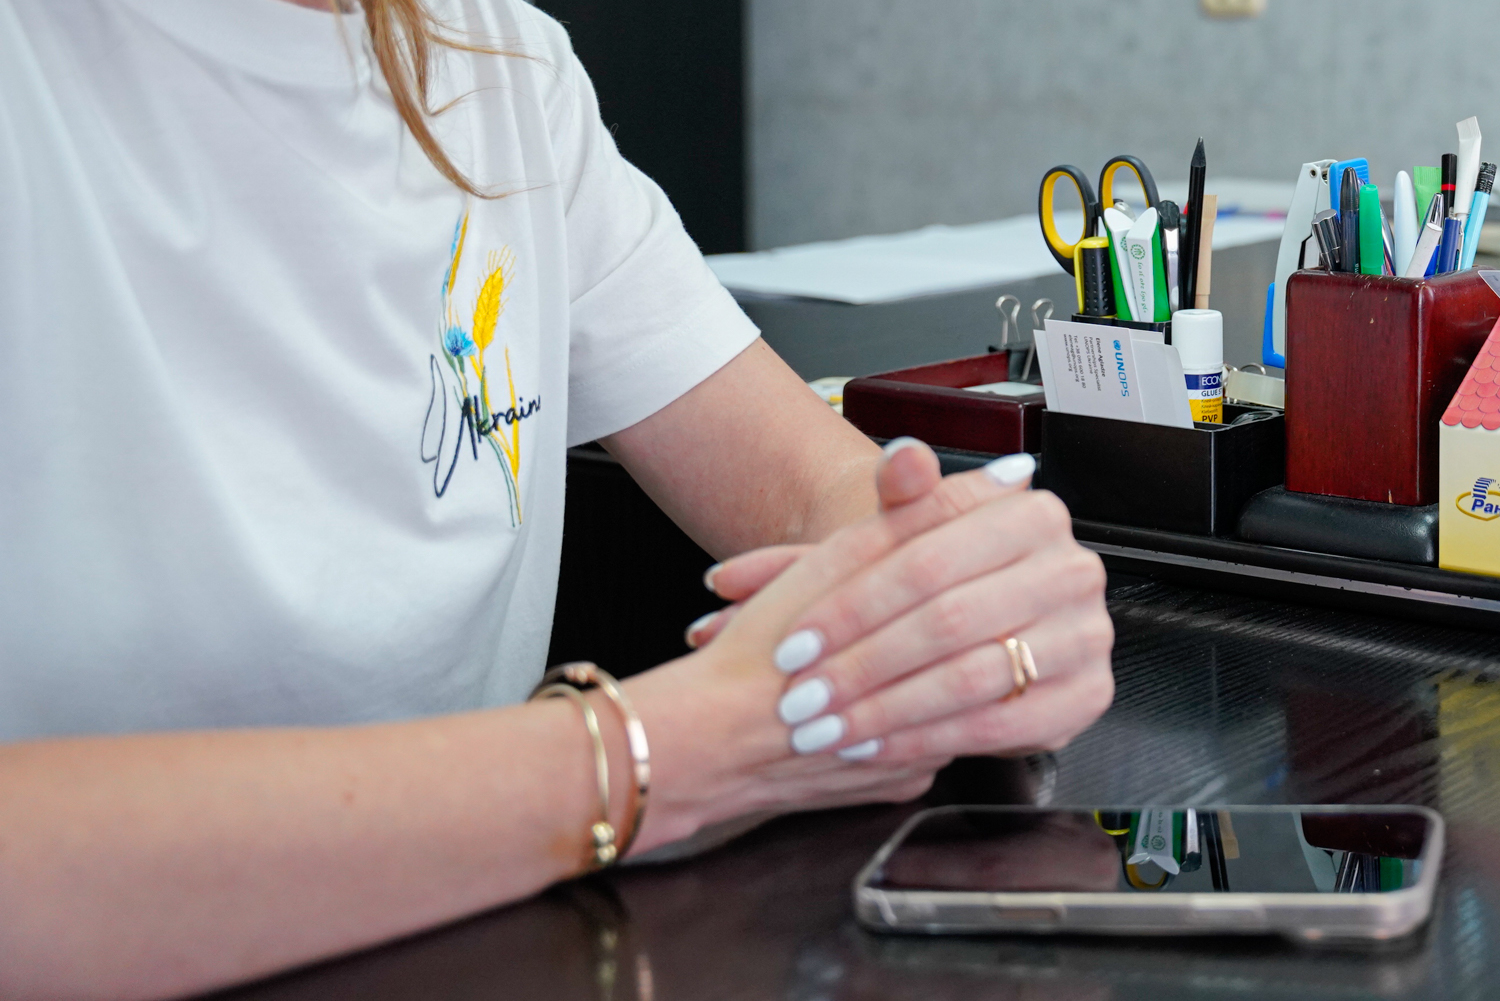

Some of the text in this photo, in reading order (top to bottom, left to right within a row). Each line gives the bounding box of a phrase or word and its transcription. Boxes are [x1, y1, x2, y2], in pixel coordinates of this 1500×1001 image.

[1115, 352, 1130, 397] UNOPS
[1201, 389, 1218, 397] GLUE
[421, 354, 541, 498] Ukrain
[1202, 414, 1218, 423] PVP
